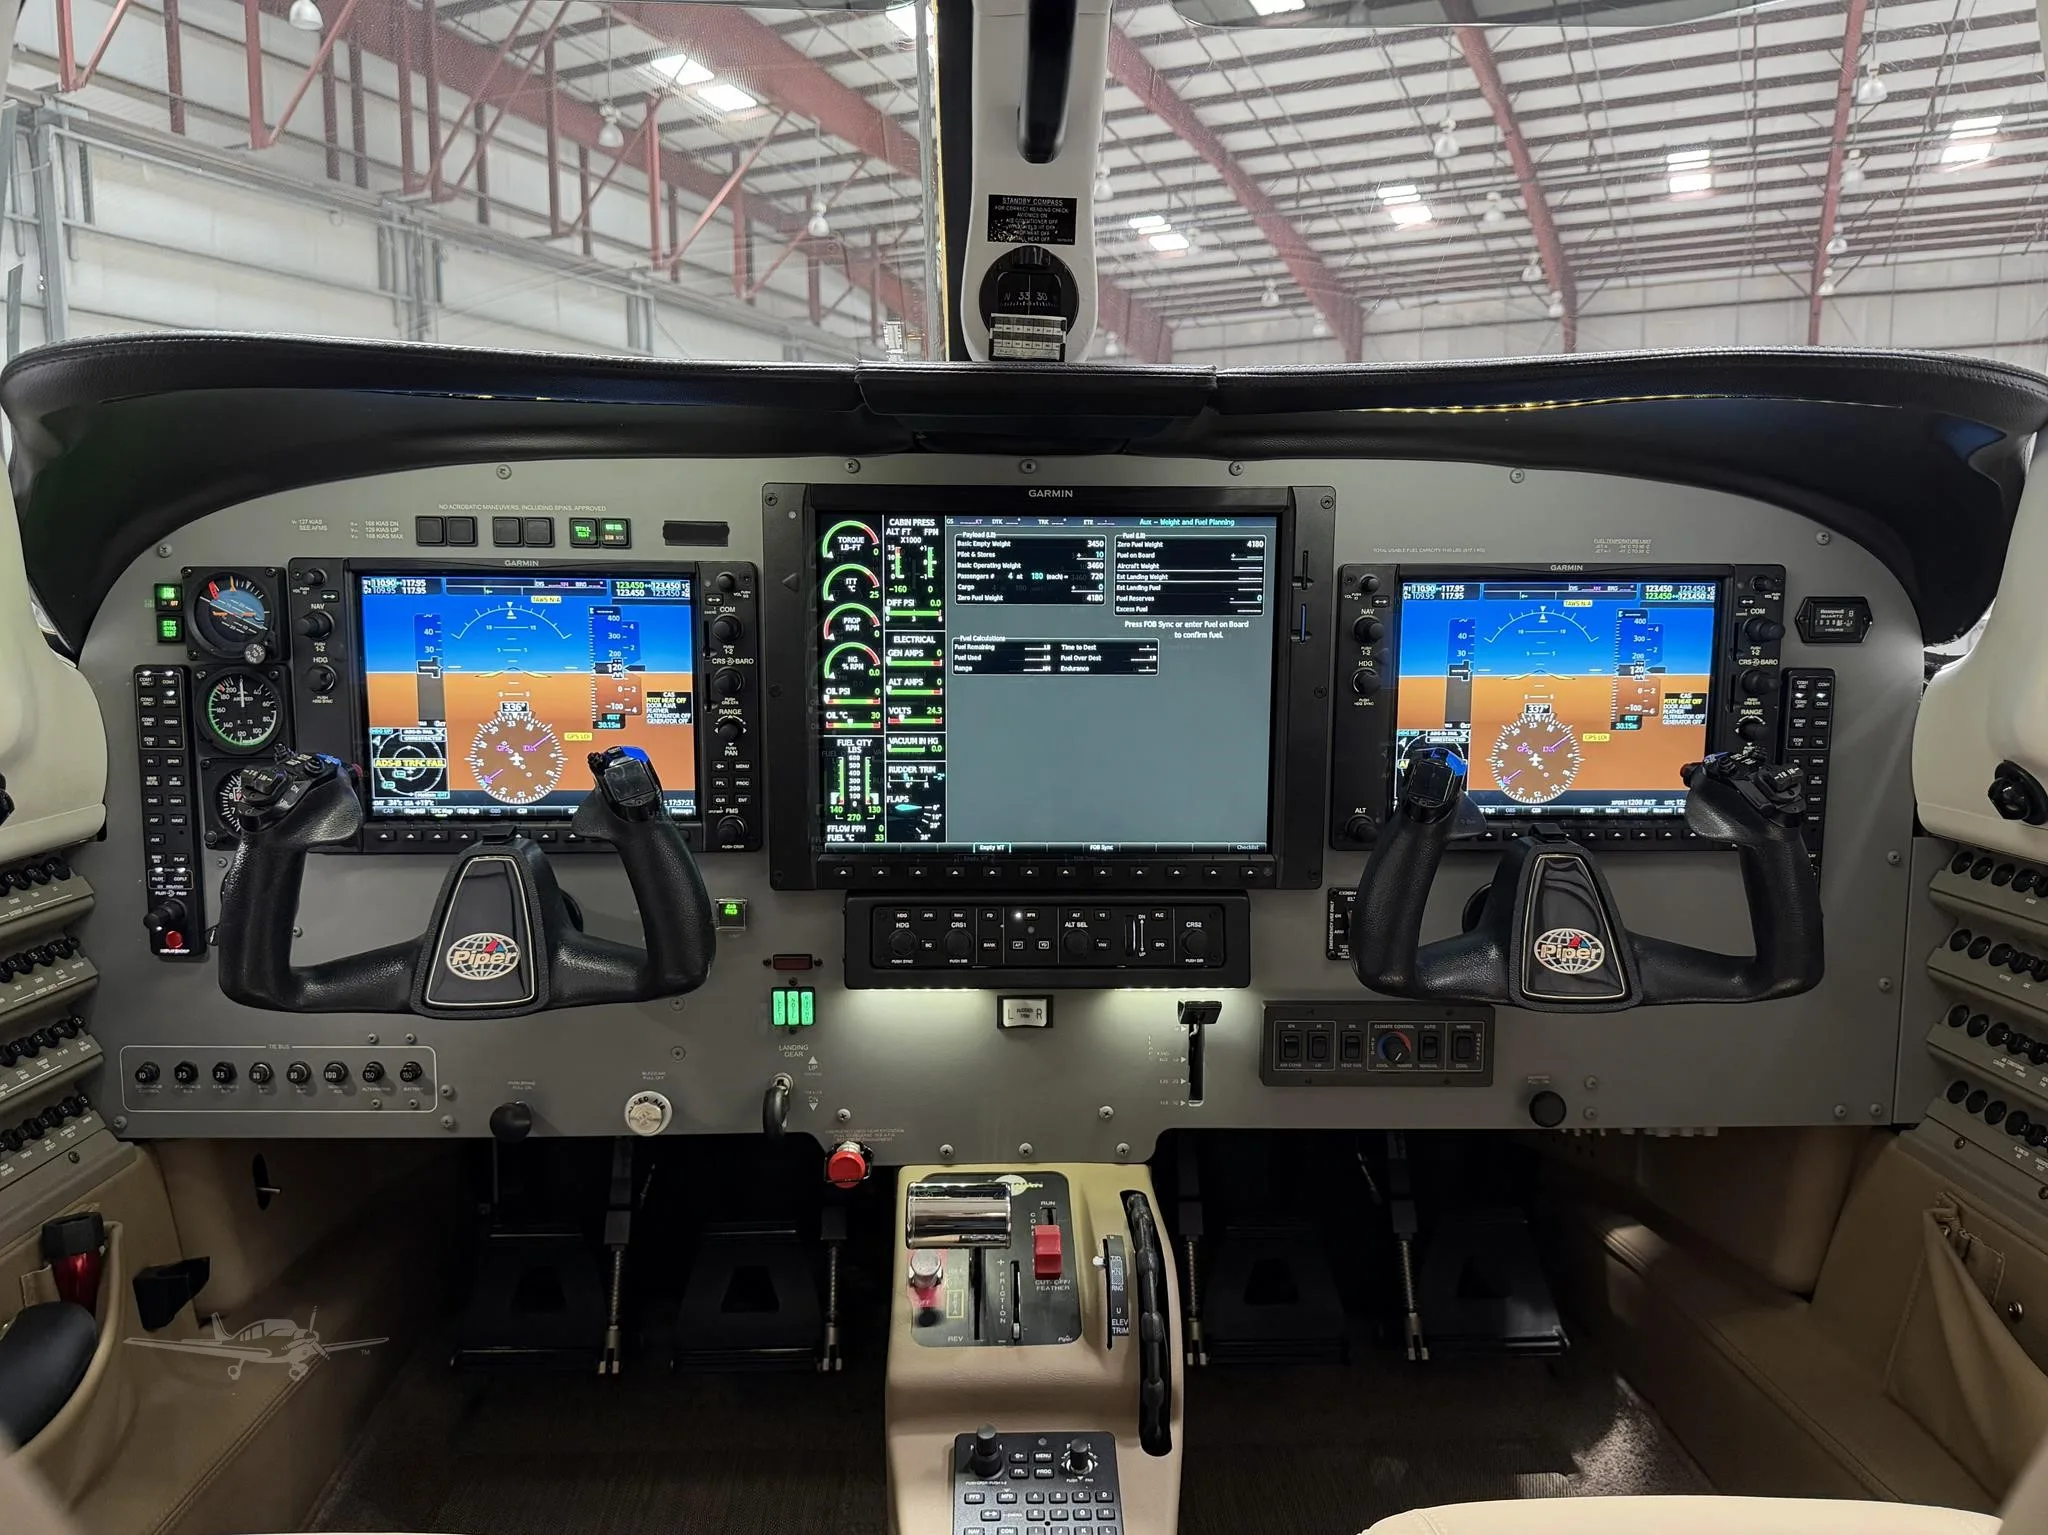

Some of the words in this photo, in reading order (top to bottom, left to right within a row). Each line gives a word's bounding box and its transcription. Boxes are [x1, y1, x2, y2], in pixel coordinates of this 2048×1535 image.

[1002, 197, 1030, 205] STANDBY
[1033, 198, 1063, 206] COMPASS
[1018, 291, 1030, 300] 33
[1028, 489, 1073, 498] GARMIN
[889, 518, 911, 526] CABIN
[1160, 518, 1181, 527] Weight
[1208, 519, 1235, 527] Planning
[504, 559, 539, 567] GARMIN
[402, 587, 427, 595] 117.95
[1441, 592, 1464, 600] 117.95
[930, 599, 941, 607] 0.0
[1158, 621, 1174, 629] Sync
[1183, 631, 1208, 639] confirm
[856, 739, 873, 747] QTY
[1540, 944, 1601, 962] Piper
[451, 950, 518, 968] Piper
[1007, 1008, 1014, 1020] L
[1036, 1008, 1043, 1020] R
